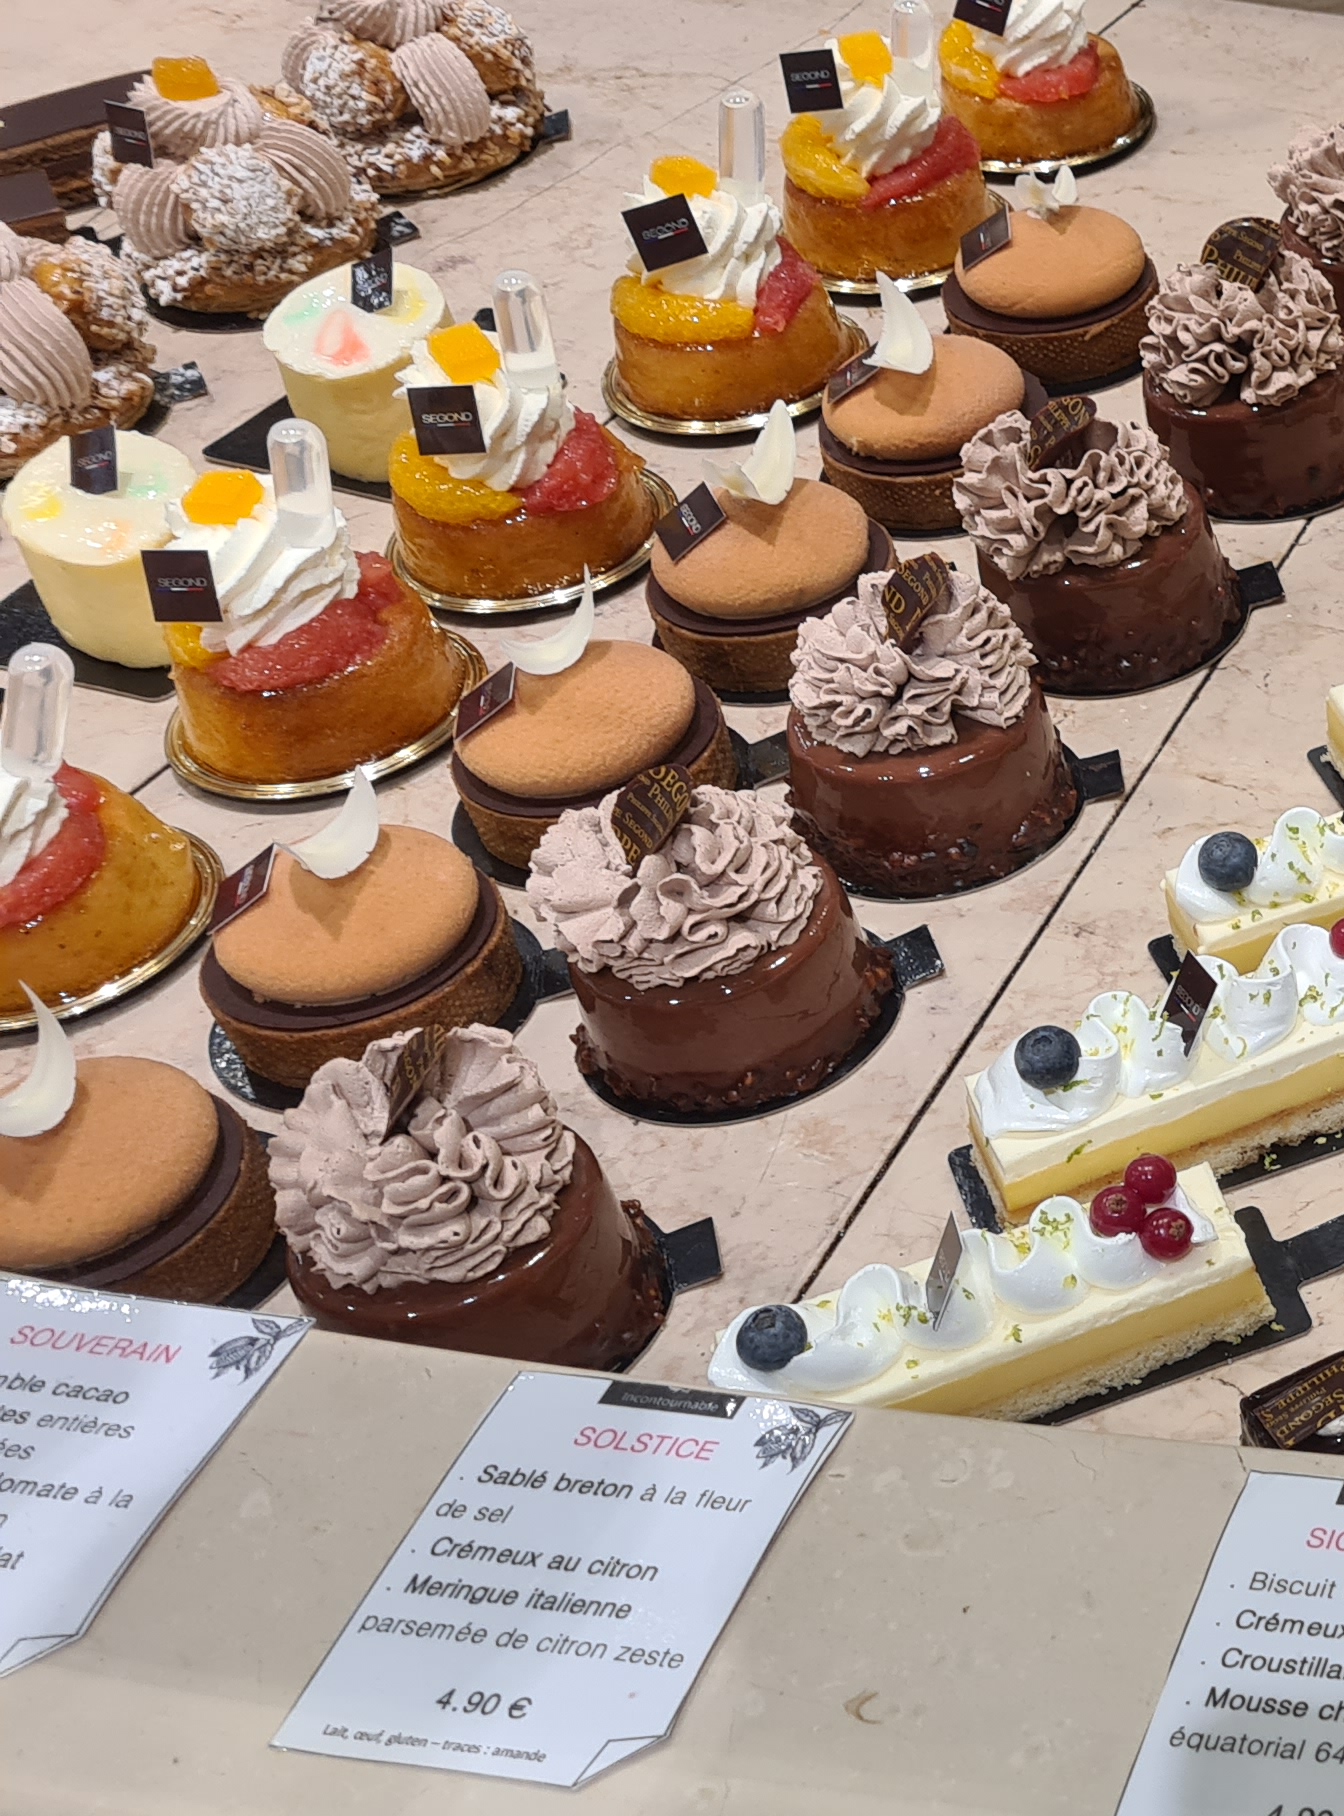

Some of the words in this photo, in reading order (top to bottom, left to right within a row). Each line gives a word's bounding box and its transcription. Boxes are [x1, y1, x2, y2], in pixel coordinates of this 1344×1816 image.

[421, 411, 473, 425] SEGOND
[157, 577, 208, 589] SEGOND
[10, 1324, 181, 1364] SOUVERAIN
[51, 1382, 130, 1405] cacao
[37, 1414, 135, 1439] entières
[573, 1425, 720, 1462] SOLSTICE
[0, 1472, 78, 1501] omate
[84, 1487, 103, 1505] à
[109, 1489, 134, 1509] la
[476, 1464, 547, 1490] Sablé
[553, 1473, 633, 1501] breton
[640, 1484, 657, 1502] à
[664, 1486, 687, 1506] la
[695, 1489, 752, 1514] fleur
[435, 1498, 468, 1519] de
[473, 1504, 513, 1524] sel
[429, 1536, 543, 1569] Crémeux
[547, 1554, 582, 1572] au
[587, 1556, 659, 1582] citron
[403, 1573, 519, 1610] Meringue
[525, 1587, 632, 1620] italienne
[1249, 1570, 1337, 1600] Biscuit
[358, 1613, 488, 1645] parsemée
[495, 1627, 529, 1650] de
[535, 1635, 608, 1660] citron
[613, 1645, 685, 1670] zeste
[436, 1687, 502, 1717] 4.90
[507, 1697, 533, 1720] €
[1204, 1685, 1309, 1719] Mousse
[386, 1731, 429, 1749] gluten
[442, 1739, 482, 1755] traces
[491, 1744, 547, 1763] amande
[1168, 1725, 1306, 1762] équatorial
